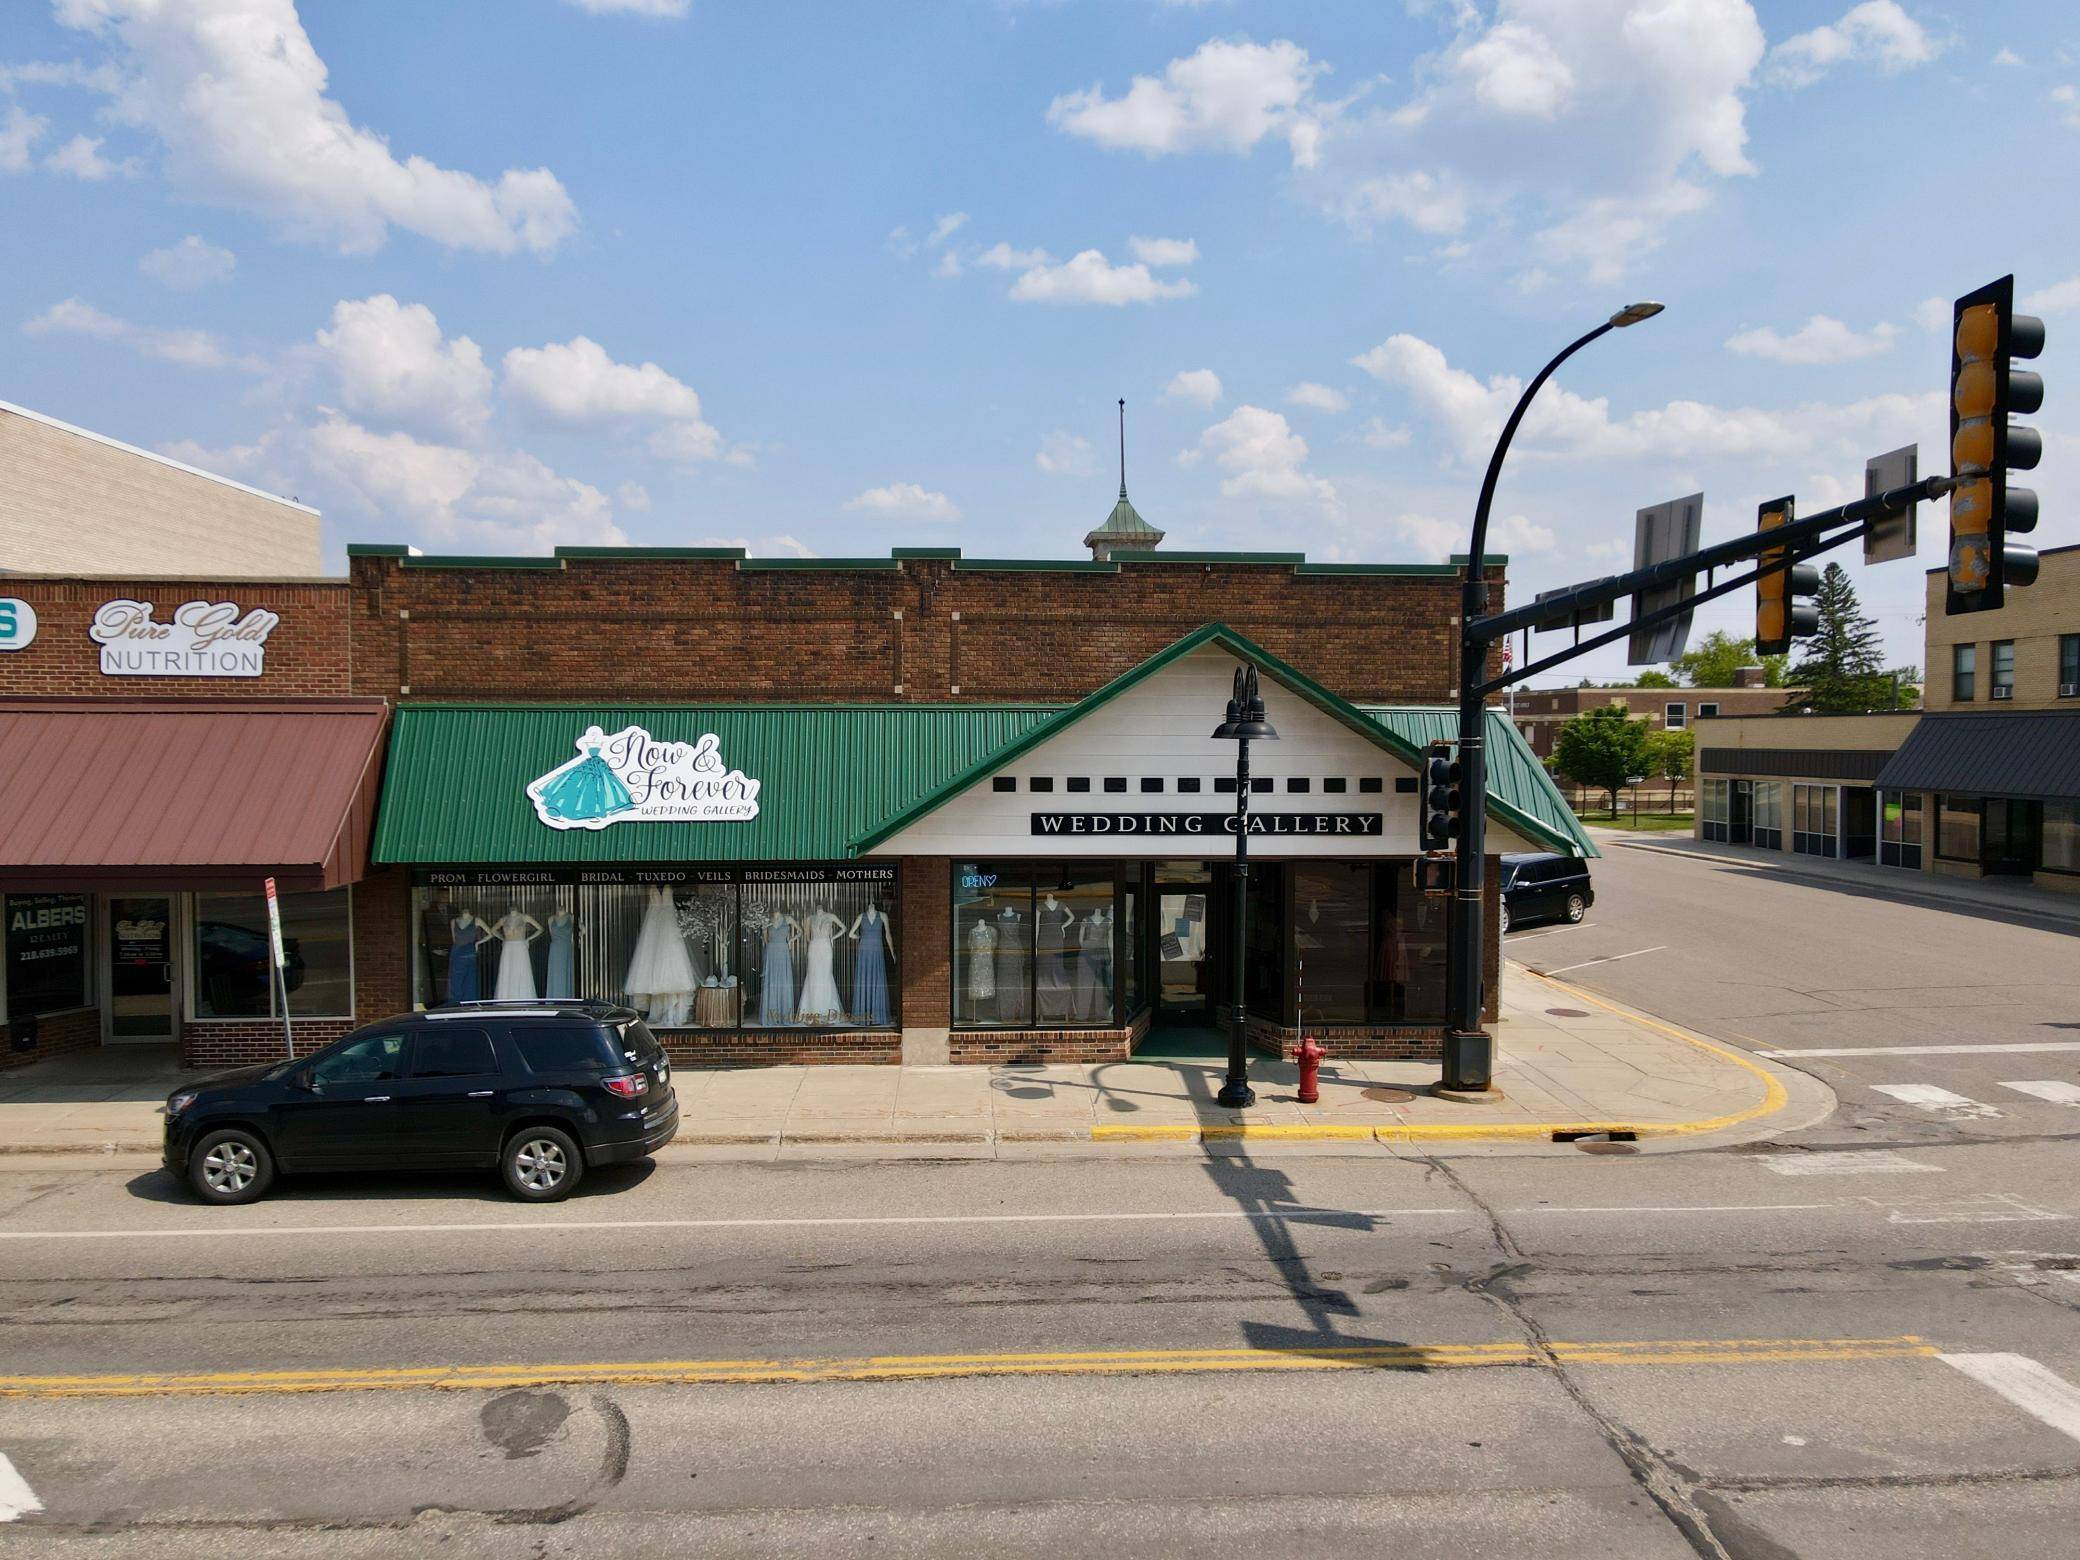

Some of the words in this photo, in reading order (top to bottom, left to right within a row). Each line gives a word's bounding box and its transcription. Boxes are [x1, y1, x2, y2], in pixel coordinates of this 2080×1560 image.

[96, 605, 170, 640] Pure
[180, 606, 274, 650] Gold
[105, 652, 258, 672] NUTRITION
[608, 731, 688, 770] Now
[692, 739, 721, 773] &
[626, 766, 755, 805] Forever
[641, 805, 698, 815] WEDDING
[703, 804, 752, 817] GALLERY
[1040, 816, 1203, 833] WEDDING
[1223, 815, 1376, 833] GALLERY
[430, 874, 466, 883] PROM
[477, 873, 556, 882] FLOWERGIRL
[581, 872, 625, 882] BRIDAL
[636, 872, 686, 881] TUXEDO
[697, 872, 732, 881] VEILS
[745, 871, 825, 880] BRIDESMAIDS
[836, 870, 894, 879] MOTHERS
[11, 905, 87, 931] ALBERS
